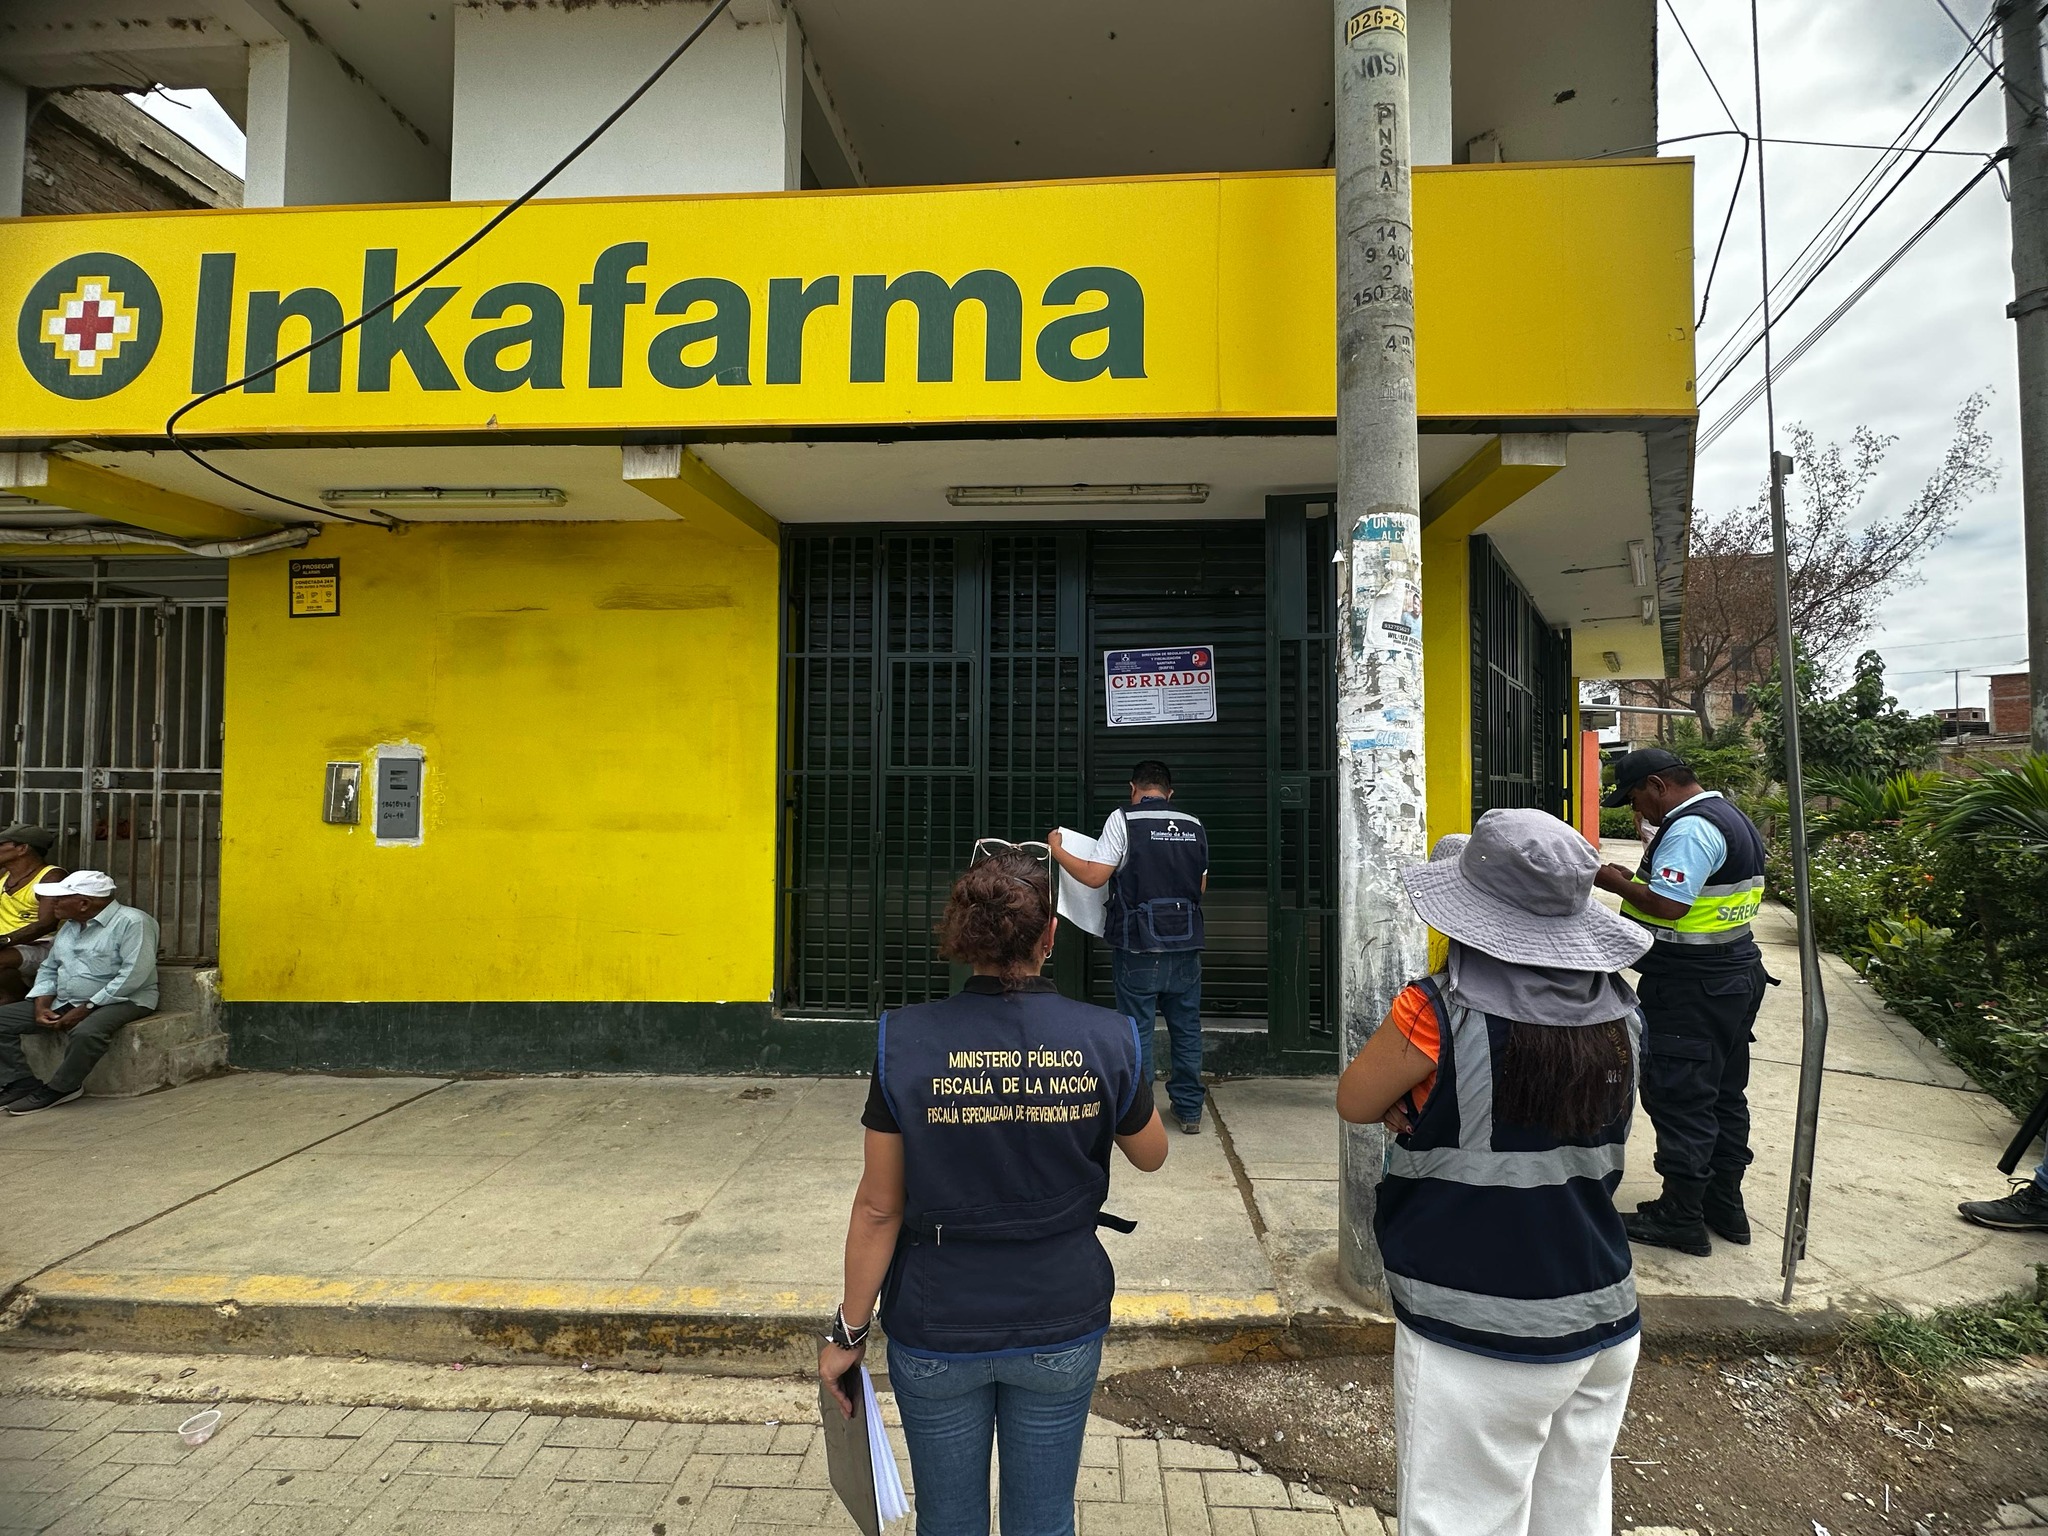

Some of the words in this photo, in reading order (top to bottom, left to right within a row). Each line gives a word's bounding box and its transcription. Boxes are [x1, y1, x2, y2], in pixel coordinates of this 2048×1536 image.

[1376, 226, 1397, 241] 14
[1383, 265, 1393, 281] 2
[1352, 285, 1384, 307] 150
[191, 241, 1148, 395] Inkafarma
[1373, 517, 1388, 529] UN
[1381, 530, 1392, 541] AL
[1112, 672, 1210, 689] CERRADO
[949, 1050, 1022, 1069] MINISTERIO
[1028, 1044, 1083, 1068] PÚBLICO
[933, 1071, 994, 1095] FISCALÍA
[1002, 1077, 1020, 1094] DE
[1025, 1077, 1044, 1094] LA
[1049, 1070, 1099, 1095] NACIÓN
[927, 1101, 960, 1124] FISCALÍA
[962, 1104, 1014, 1125] ESPECIALIZADA
[1015, 1104, 1025, 1122] DE
[1025, 1100, 1069, 1123] PREVENCIÓN
[1069, 1105, 1081, 1121] DEL
[1081, 1101, 1101, 1119] DELITO
